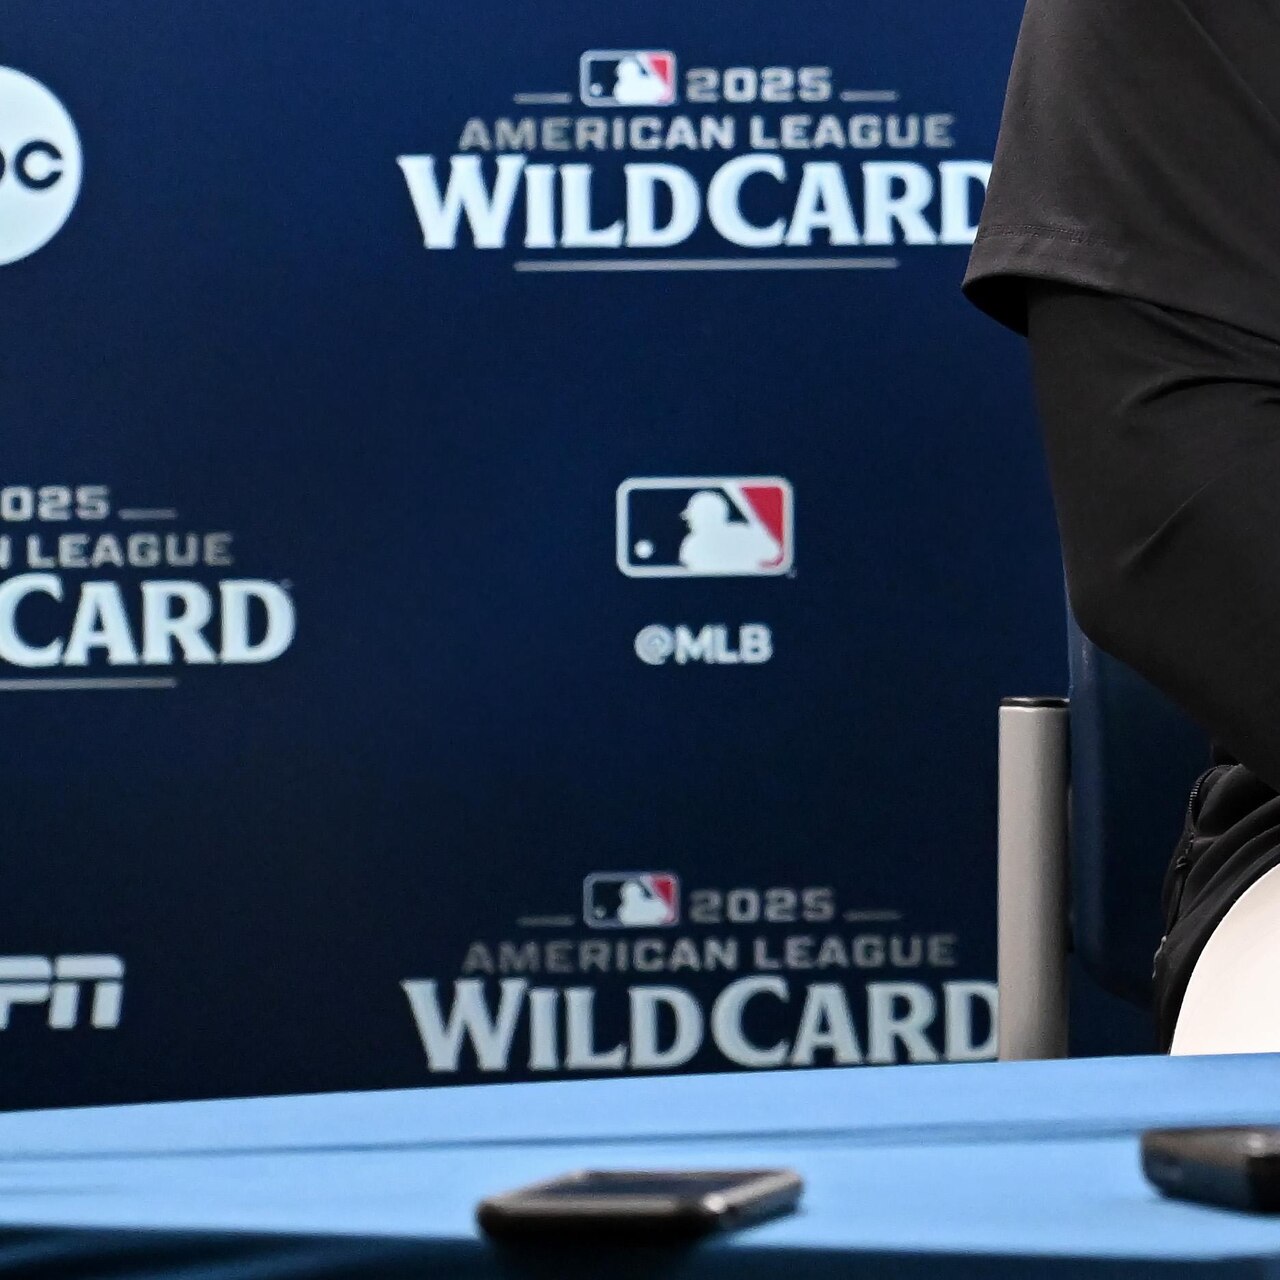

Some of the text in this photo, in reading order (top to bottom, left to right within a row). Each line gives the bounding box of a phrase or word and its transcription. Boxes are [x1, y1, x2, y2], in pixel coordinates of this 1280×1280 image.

[687, 67, 831, 102] 2025
[460, 115, 951, 149] AMERICAN LEAGUE
[26, 532, 234, 569] LEAGUE
[635, 624, 772, 665] @MLB
[691, 889, 833, 922] 2025
[462, 936, 957, 971] AMERICAN LEAGUE
